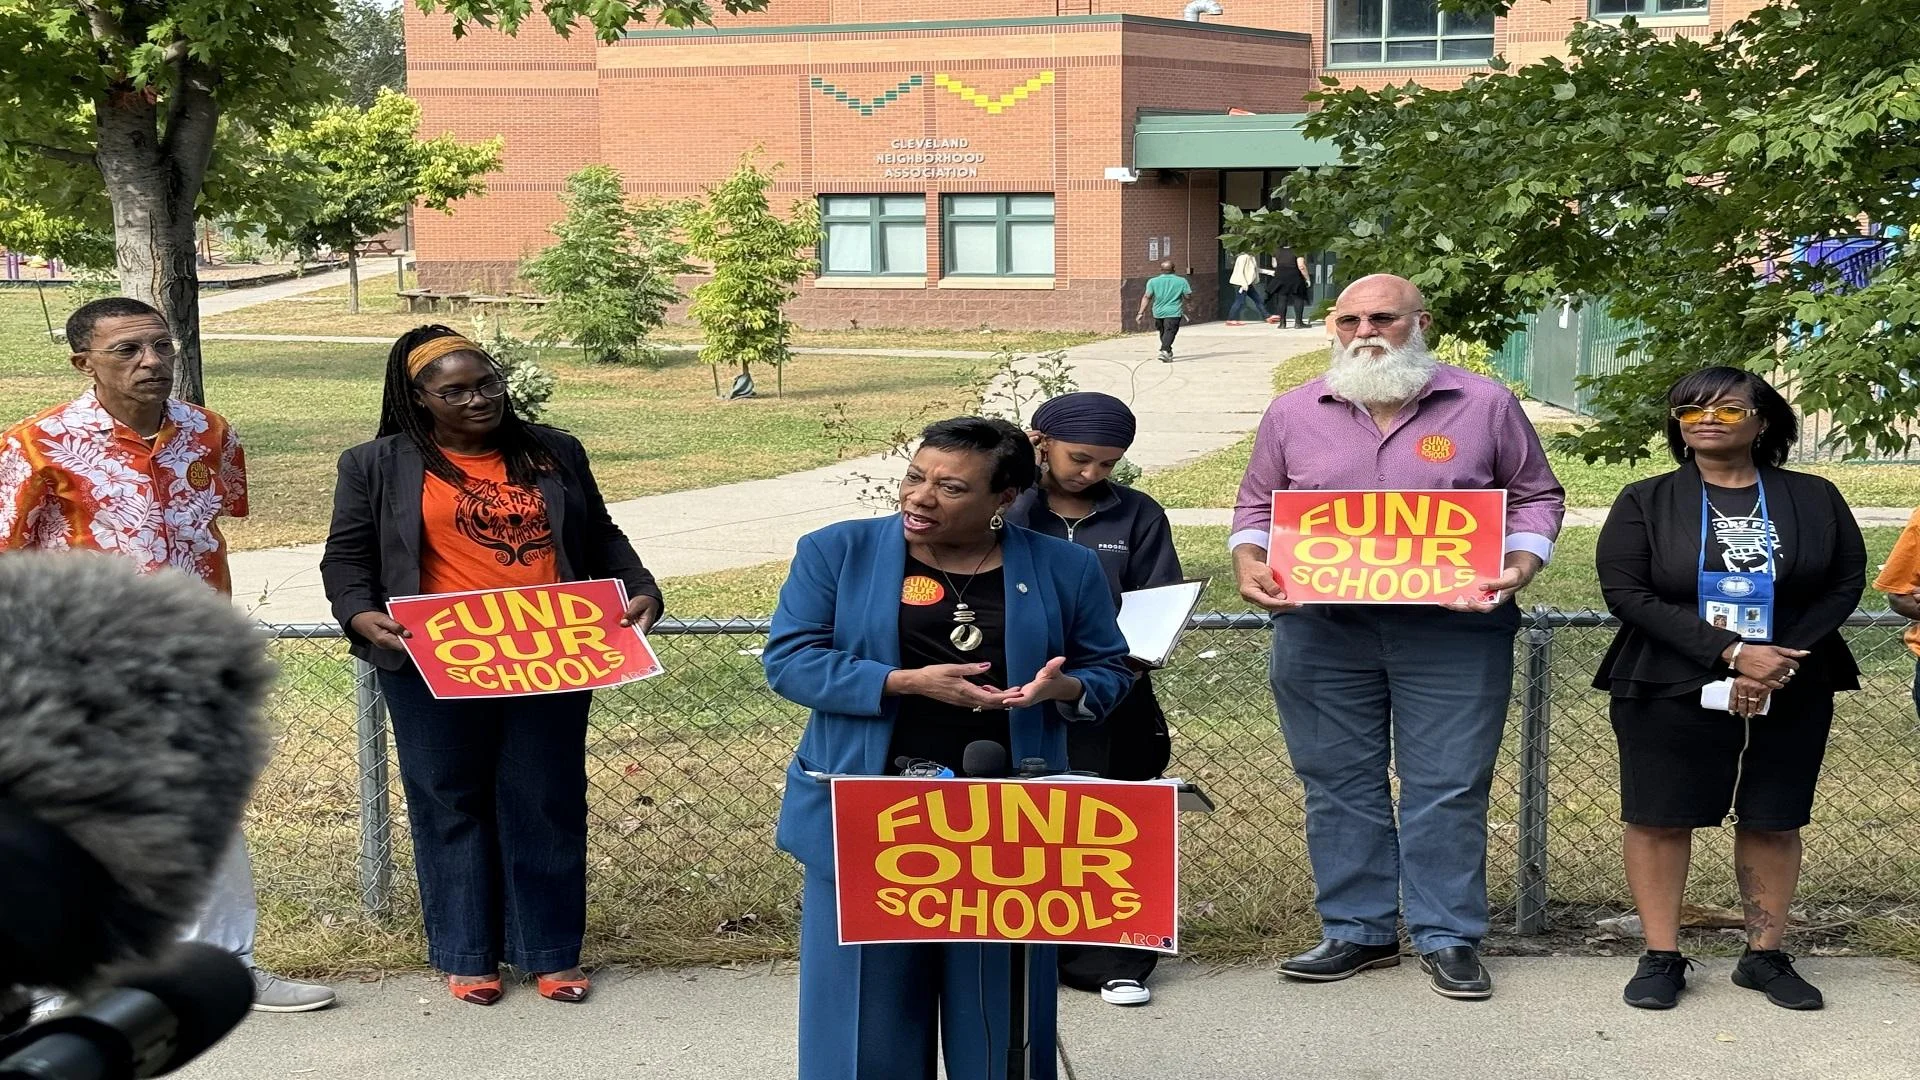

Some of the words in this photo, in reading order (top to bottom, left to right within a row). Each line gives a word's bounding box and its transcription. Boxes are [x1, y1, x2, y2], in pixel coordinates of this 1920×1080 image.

[891, 138, 969, 149] CLEVELAND
[876, 152, 985, 164] NEIGHBORHOOD
[884, 167, 978, 178] ASSOCIATION
[1421, 444, 1450, 452] OUR
[1422, 435, 1451, 446] FUND
[191, 471, 208, 479] OUR
[508, 490, 545, 513] HEAR
[1299, 492, 1478, 536] FUND
[1293, 536, 1472, 567] OUR
[903, 577, 939, 589] FUND
[903, 585, 937, 595] OUR
[1291, 565, 1476, 601] SCHOOLS
[424, 590, 604, 641] FUND
[434, 625, 614, 666] OUR
[445, 649, 626, 692] SCHOOLS
[876, 783, 1138, 845] FUND
[874, 843, 1134, 889] OUR
[875, 887, 1142, 938] SCHOOLS
[1119, 931, 1173, 949] AROS
